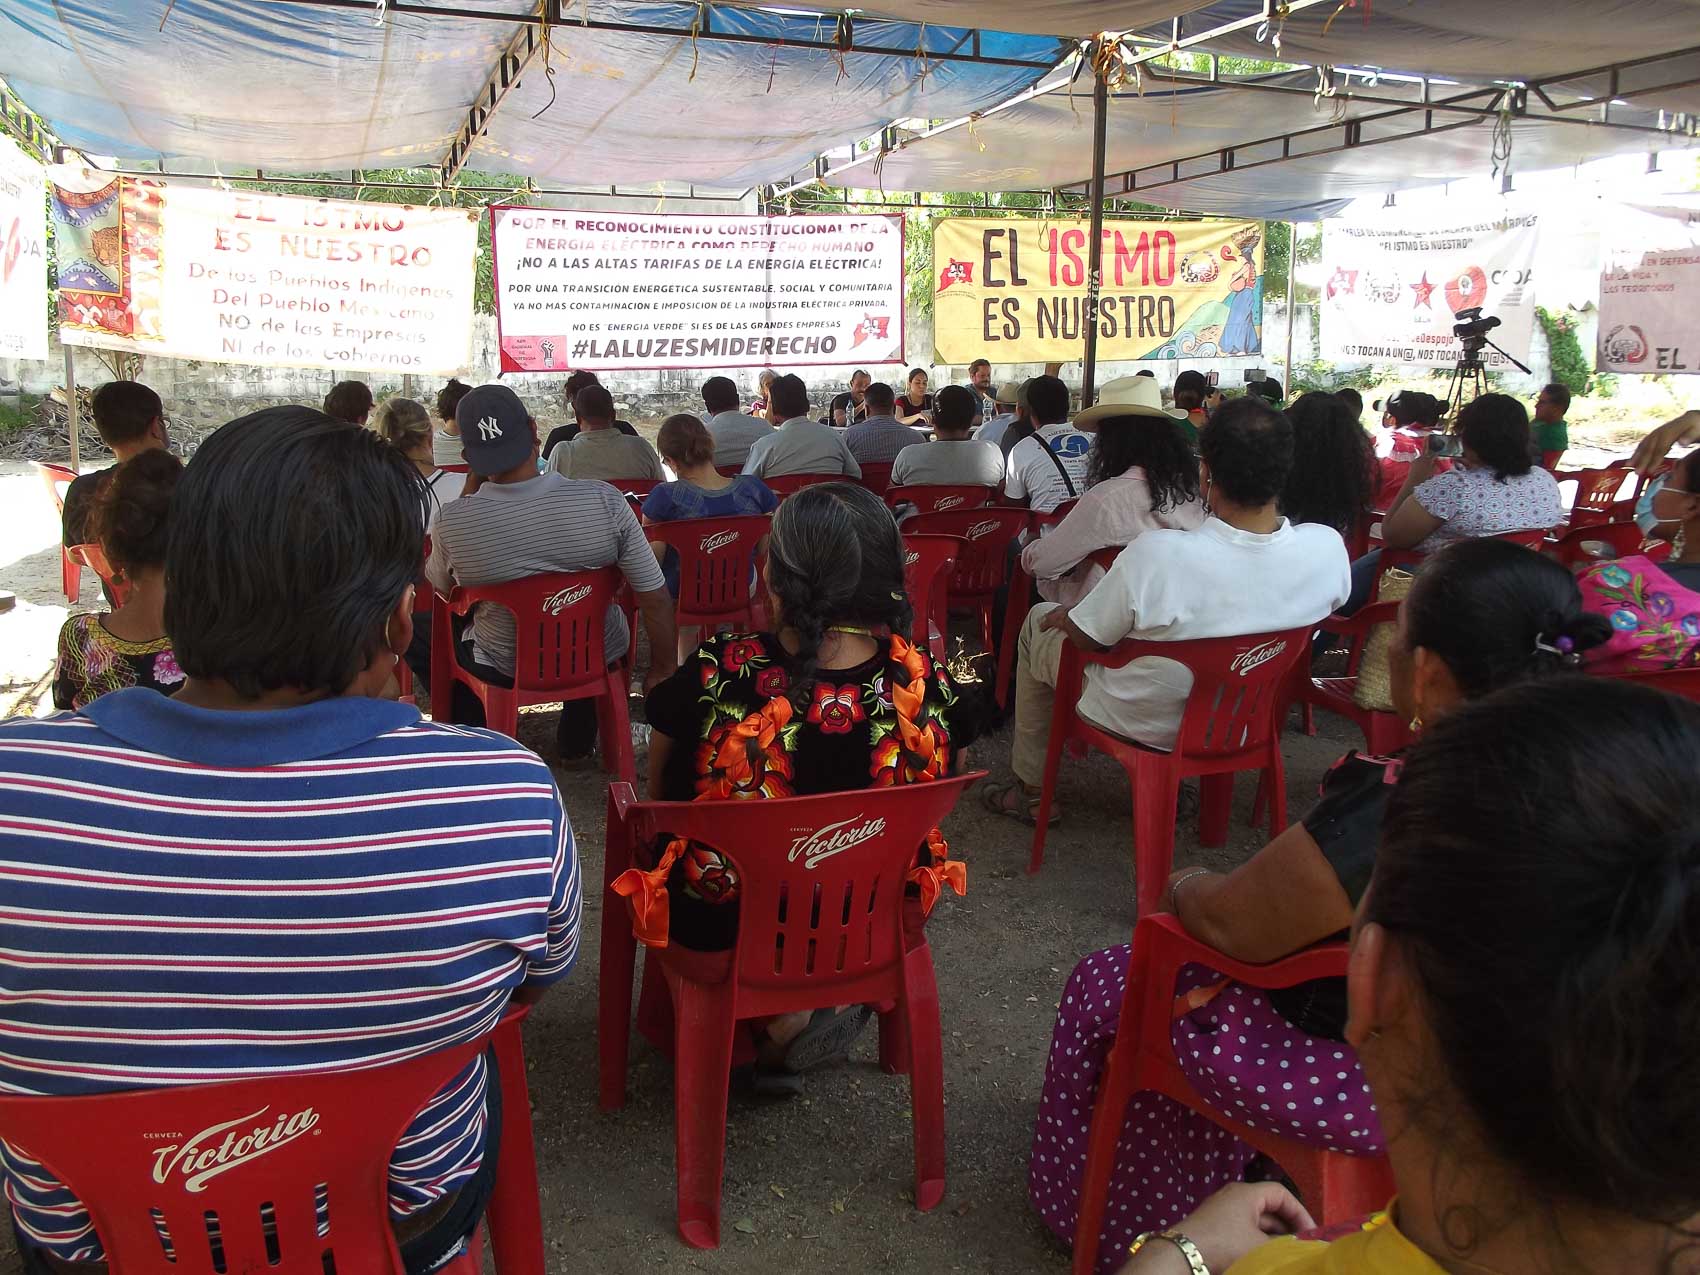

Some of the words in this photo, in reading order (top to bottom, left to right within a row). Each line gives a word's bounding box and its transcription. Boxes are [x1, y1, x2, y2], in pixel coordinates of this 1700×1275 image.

[303, 204, 405, 232] ISTMO
[512, 218, 545, 230] POR
[552, 219, 569, 230] EL
[576, 220, 713, 235] RECONOCIMIENTO
[718, 223, 844, 236] CONSTITUCIONAL
[214, 228, 251, 254] ES
[279, 233, 433, 268] NUESTRO
[812, 241, 875, 252] HUMANO
[983, 228, 1027, 287] EL
[1394, 240, 1418, 251] ISTMO
[1420, 240, 1430, 251] ES
[189, 261, 218, 279] De
[517, 257, 543, 270] ¡NO
[548, 258, 557, 268] A
[563, 258, 590, 269] LAS
[594, 258, 638, 269] ALTAS
[643, 259, 700, 269] TARIFAS
[704, 259, 722, 269] DE
[726, 259, 743, 269] LA
[508, 284, 531, 293] POR
[535, 284, 558, 293] UNA
[780, 284, 815, 293] SOCIAL
[819, 283, 826, 293] Y
[829, 282, 893, 293] COMUNITARIA
[212, 288, 248, 308] Del
[259, 292, 330, 314] Pueblo
[513, 302, 526, 310] YA
[528, 302, 542, 310] NO
[546, 302, 567, 310] MAS
[653, 302, 658, 310] E
[720, 301, 733, 309] DE
[735, 301, 746, 309] LA
[749, 301, 798, 309] INDUSTRIA
[572, 323, 585, 332] NO
[589, 323, 600, 331] ES
[691, 322, 699, 330] SI
[702, 322, 713, 330] ES
[716, 321, 728, 330] DE
[730, 321, 748, 330] LAS
[751, 321, 794, 330] GRANDES
[796, 320, 842, 329] EMPRESAS
[983, 297, 1020, 341] ES
[1091, 307, 1098, 321] LA
[218, 312, 251, 330] NO
[261, 316, 285, 334] de
[295, 319, 323, 338] las
[331, 321, 427, 345] Empresas
[252, 341, 277, 358] de
[571, 335, 837, 359] #LALUZESMIDERECHO
[1357, 345, 1385, 358] TOCAN
[1385, 347, 1391, 358] A
[1417, 349, 1434, 360] NOS
[1435, 350, 1463, 361] TOCAN
[1656, 347, 1687, 369] EL
[477, 416, 503, 440] NY
[700, 529, 739, 554] Victoria
[542, 582, 592, 615] Victoria
[1230, 637, 1286, 676] Victoria
[788, 812, 886, 869] Victoria
[152, 1104, 320, 1192] Victoria
